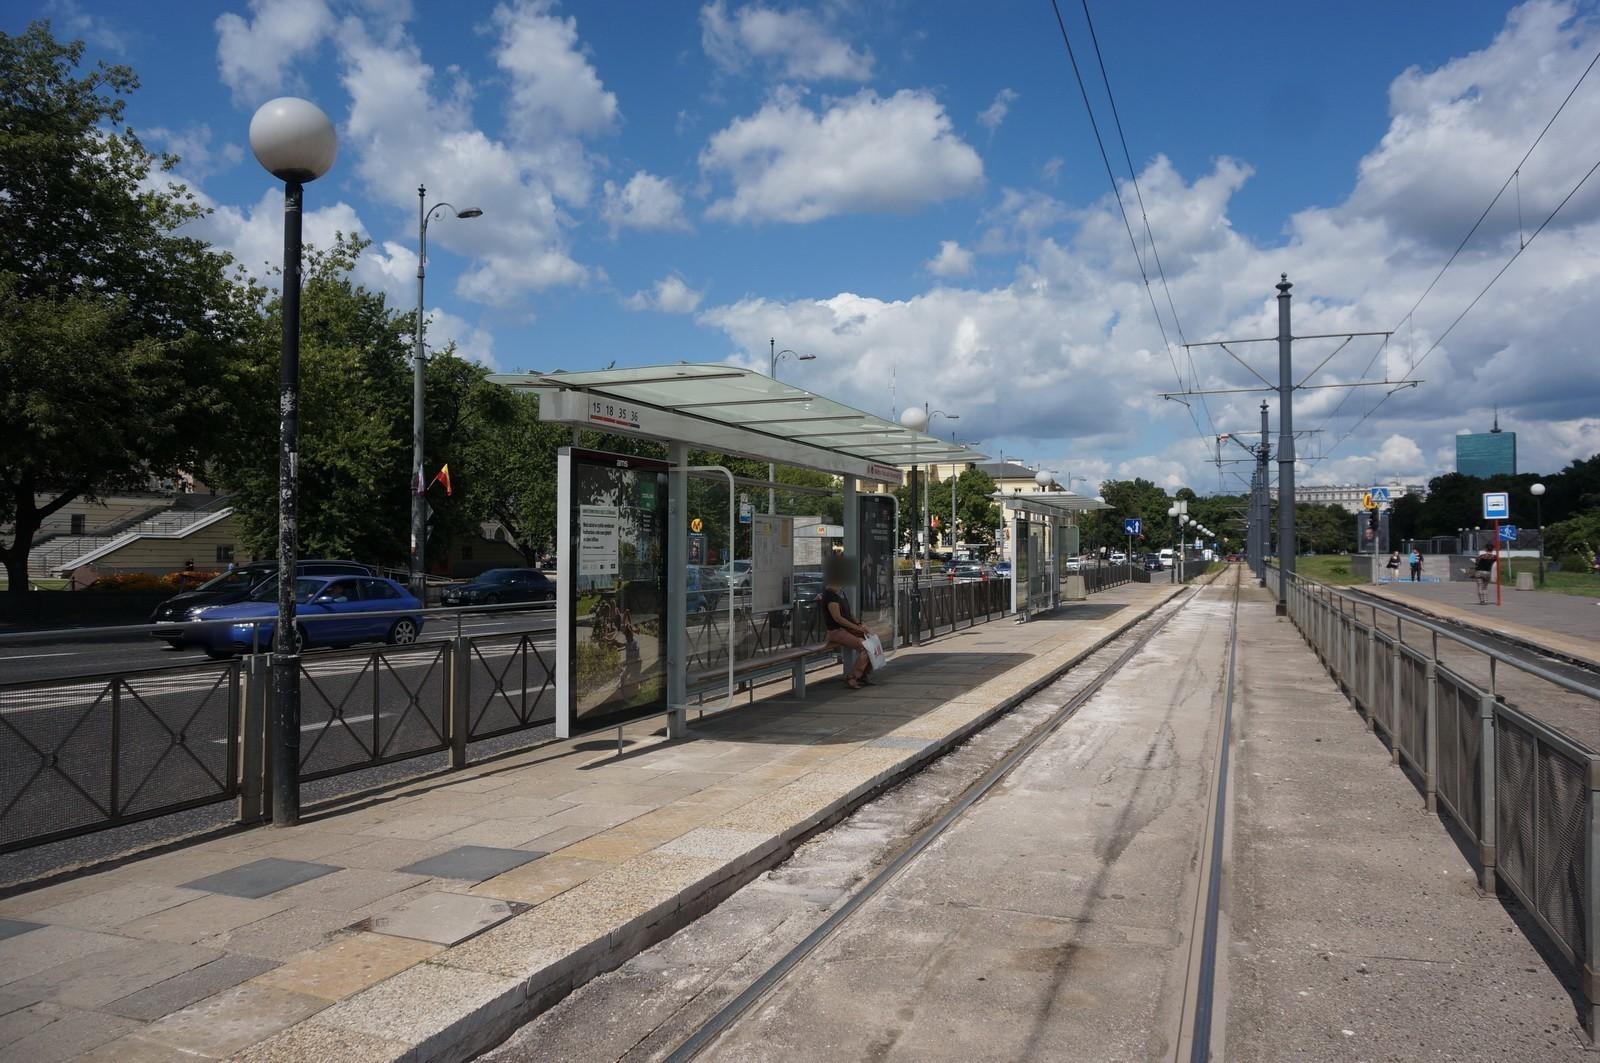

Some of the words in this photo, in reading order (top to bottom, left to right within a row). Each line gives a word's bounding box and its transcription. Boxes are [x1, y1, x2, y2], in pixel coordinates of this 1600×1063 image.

[592, 402, 601, 413] 15
[605, 405, 614, 416] 18
[618, 407, 627, 419] 35
[630, 410, 639, 422] 36
